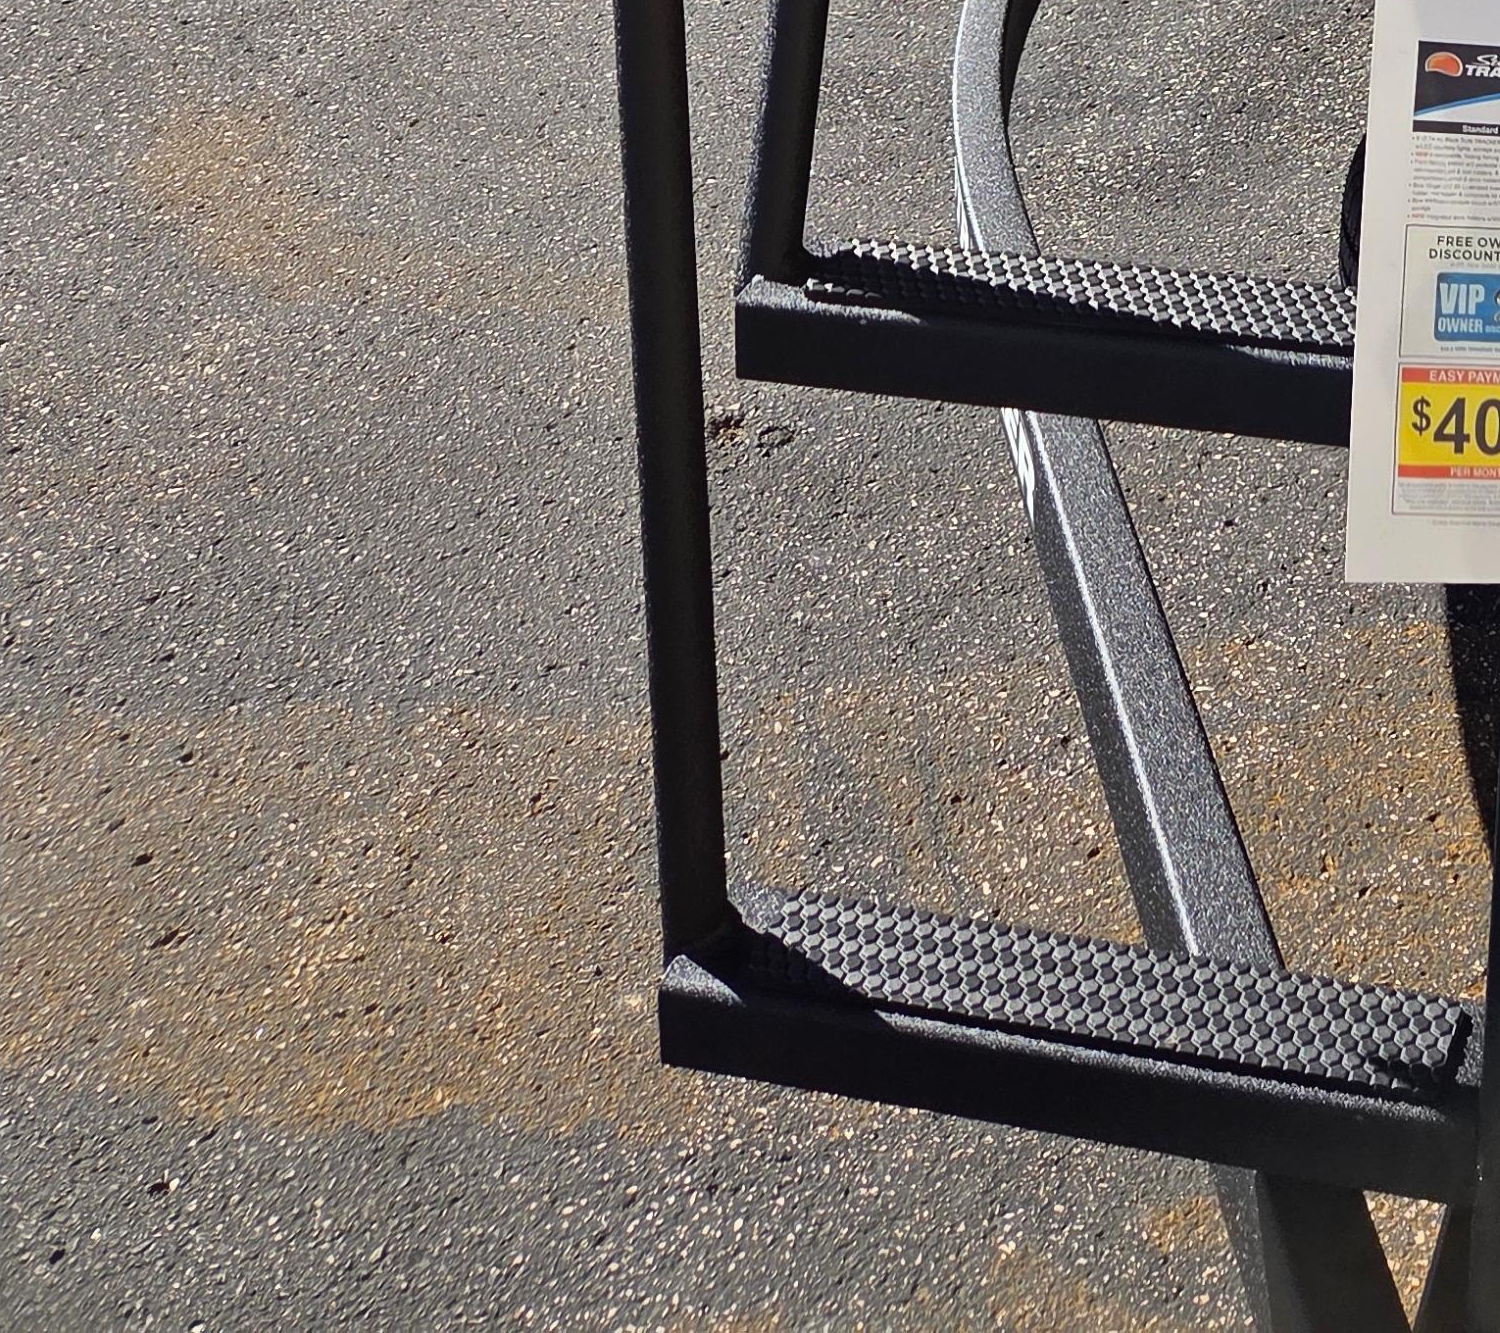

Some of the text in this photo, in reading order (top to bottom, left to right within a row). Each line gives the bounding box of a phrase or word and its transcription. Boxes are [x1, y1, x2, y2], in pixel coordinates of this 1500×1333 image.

[1462, 125, 1498, 134] Standard
[1437, 236, 1473, 247] FREE
[1440, 283, 1485, 315] VIP
[1438, 318, 1483, 333] OWNER
[1429, 370, 1465, 382] EASY
[1451, 467, 1472, 477] PER
